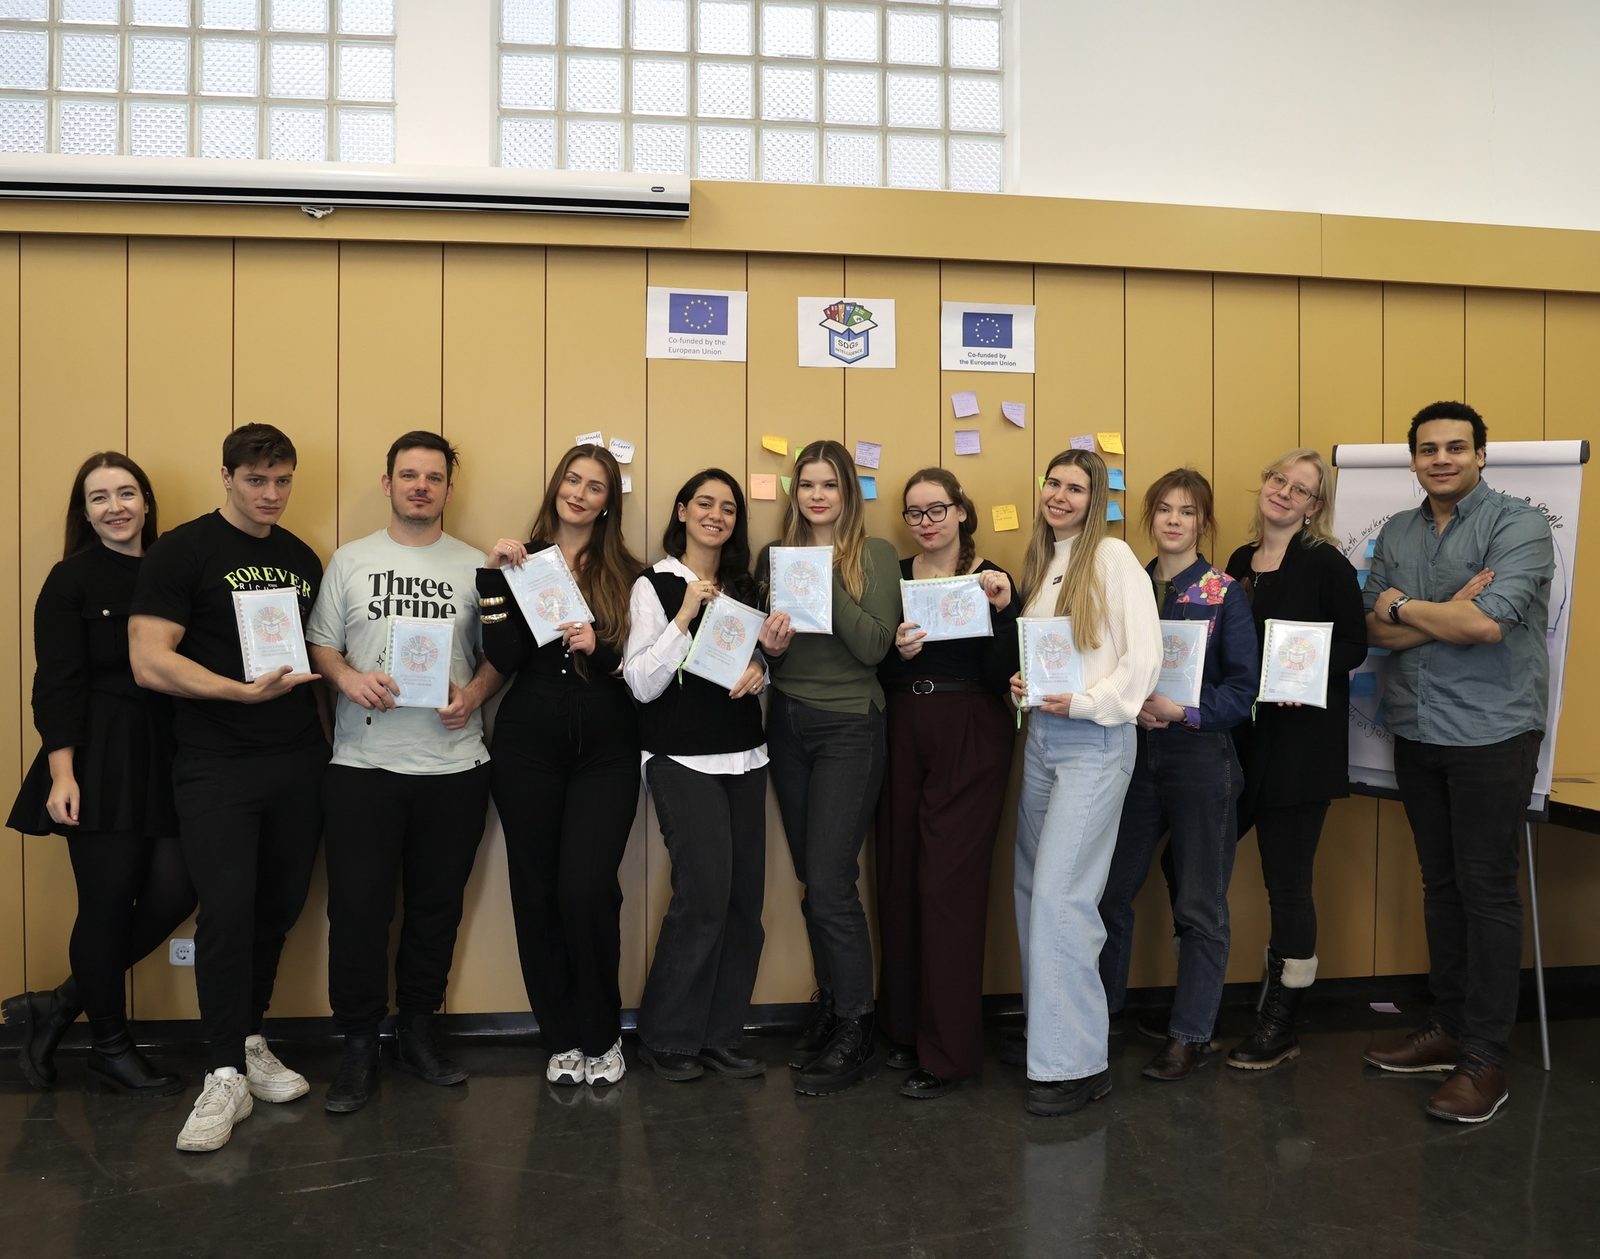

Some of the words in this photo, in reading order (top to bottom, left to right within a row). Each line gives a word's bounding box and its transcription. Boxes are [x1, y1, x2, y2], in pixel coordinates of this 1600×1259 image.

[668, 336, 704, 346] Co-funded
[704, 338, 713, 347] by
[668, 346, 700, 355] European
[701, 347, 722, 356] Union
[223, 566, 311, 596] FOREVER
[368, 569, 454, 600] Three
